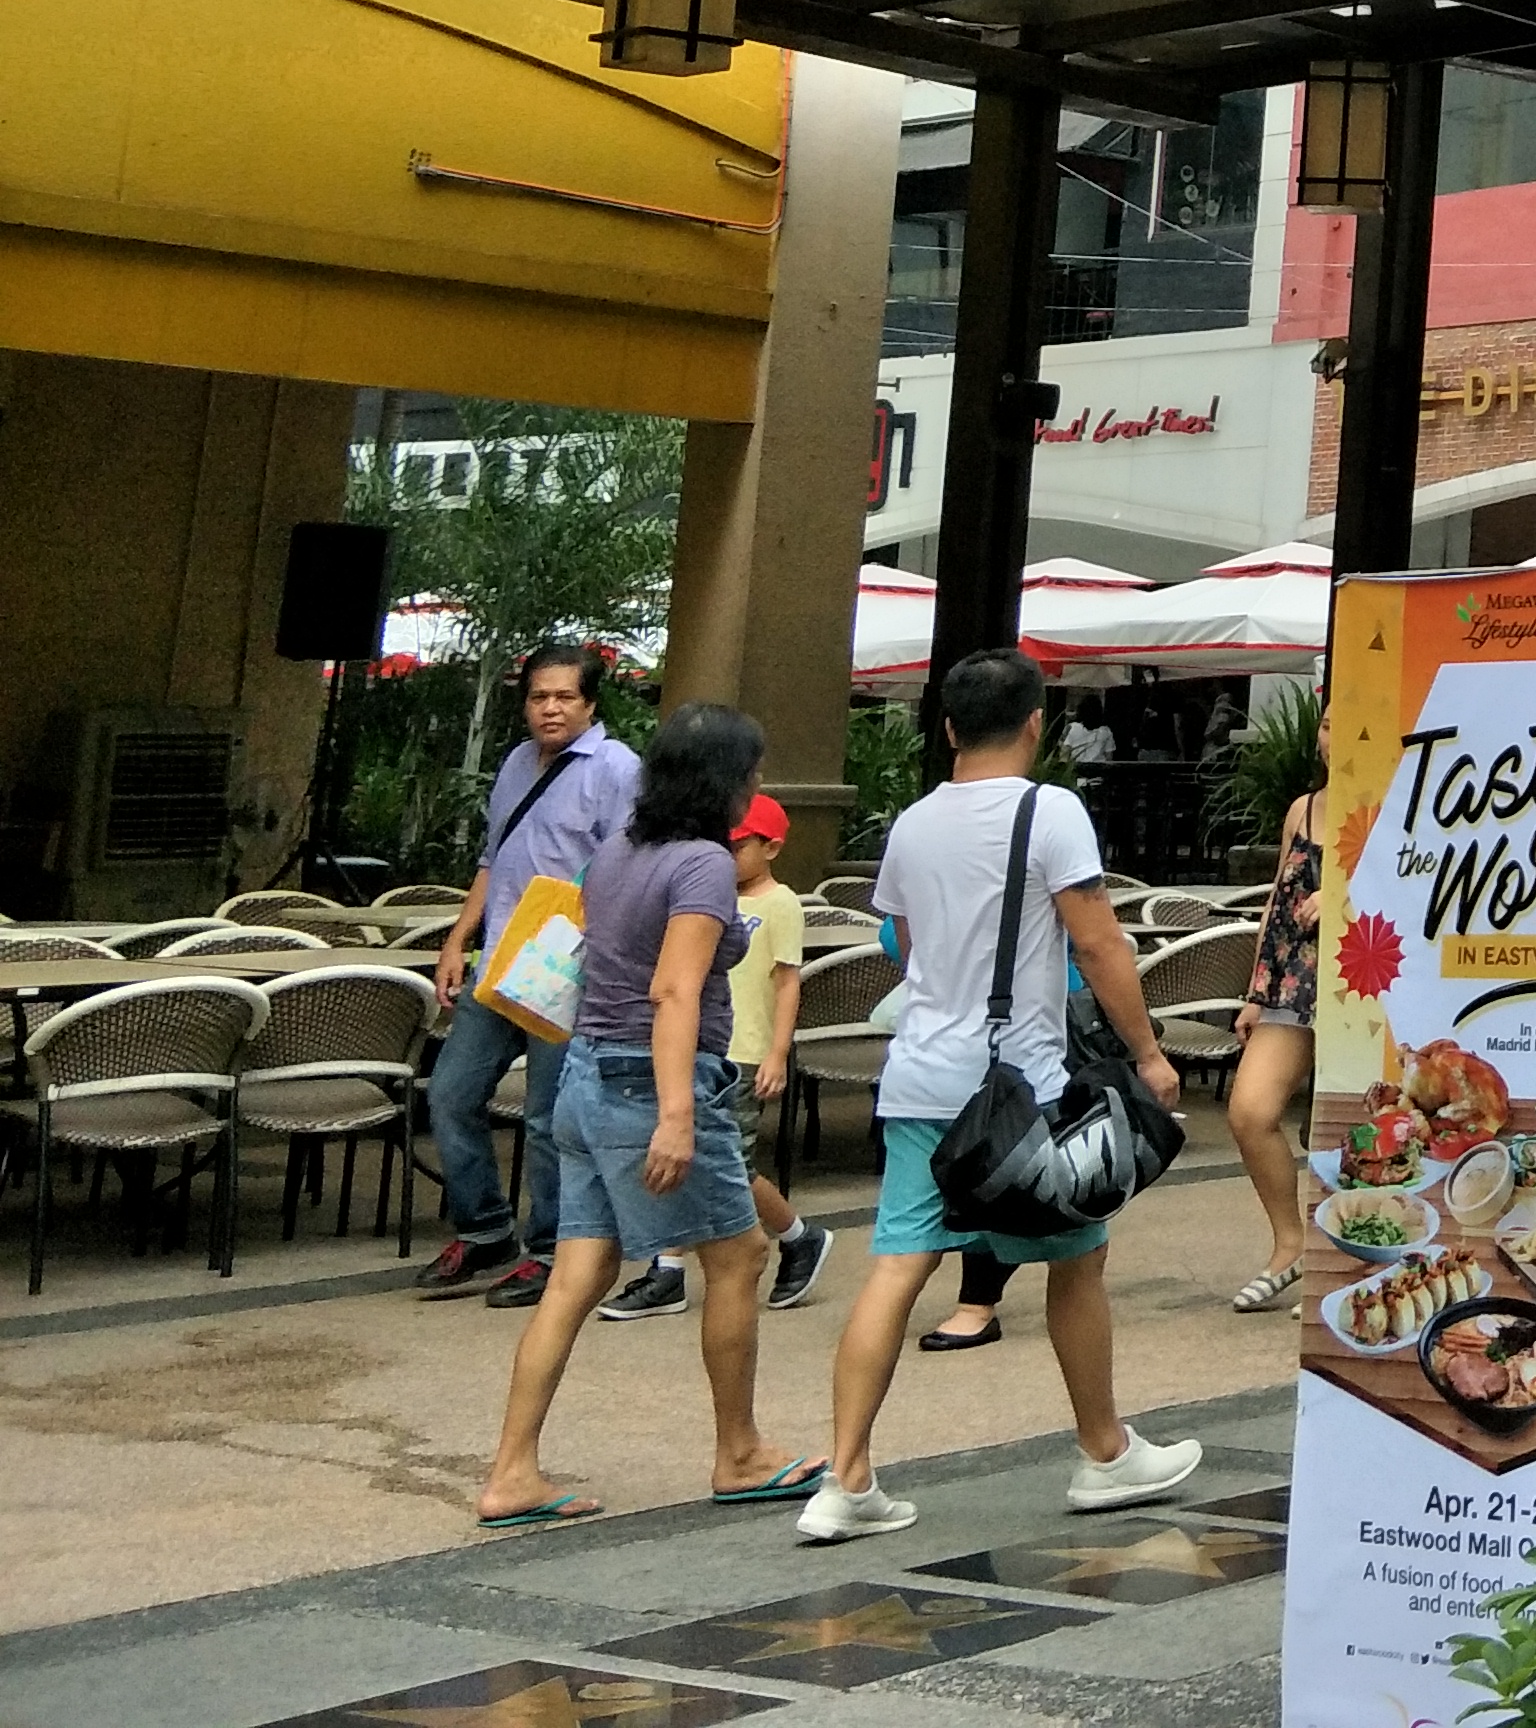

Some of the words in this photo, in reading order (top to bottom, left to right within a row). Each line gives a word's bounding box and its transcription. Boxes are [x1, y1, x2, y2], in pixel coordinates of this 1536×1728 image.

[1092, 406, 1160, 443] Great
[1397, 840, 1438, 878] the
[1457, 946, 1477, 965] IN
[1520, 1023, 1532, 1036] In
[1486, 1037, 1531, 1052] Madrid
[1424, 1485, 1478, 1522] Apr.
[1359, 1520, 1461, 1553] Eastwood
[1468, 1532, 1511, 1558] Mall
[1363, 1561, 1376, 1581] A
[1381, 1563, 1434, 1588] fusion
[1439, 1570, 1458, 1590] of
[1408, 1594, 1441, 1614] and
